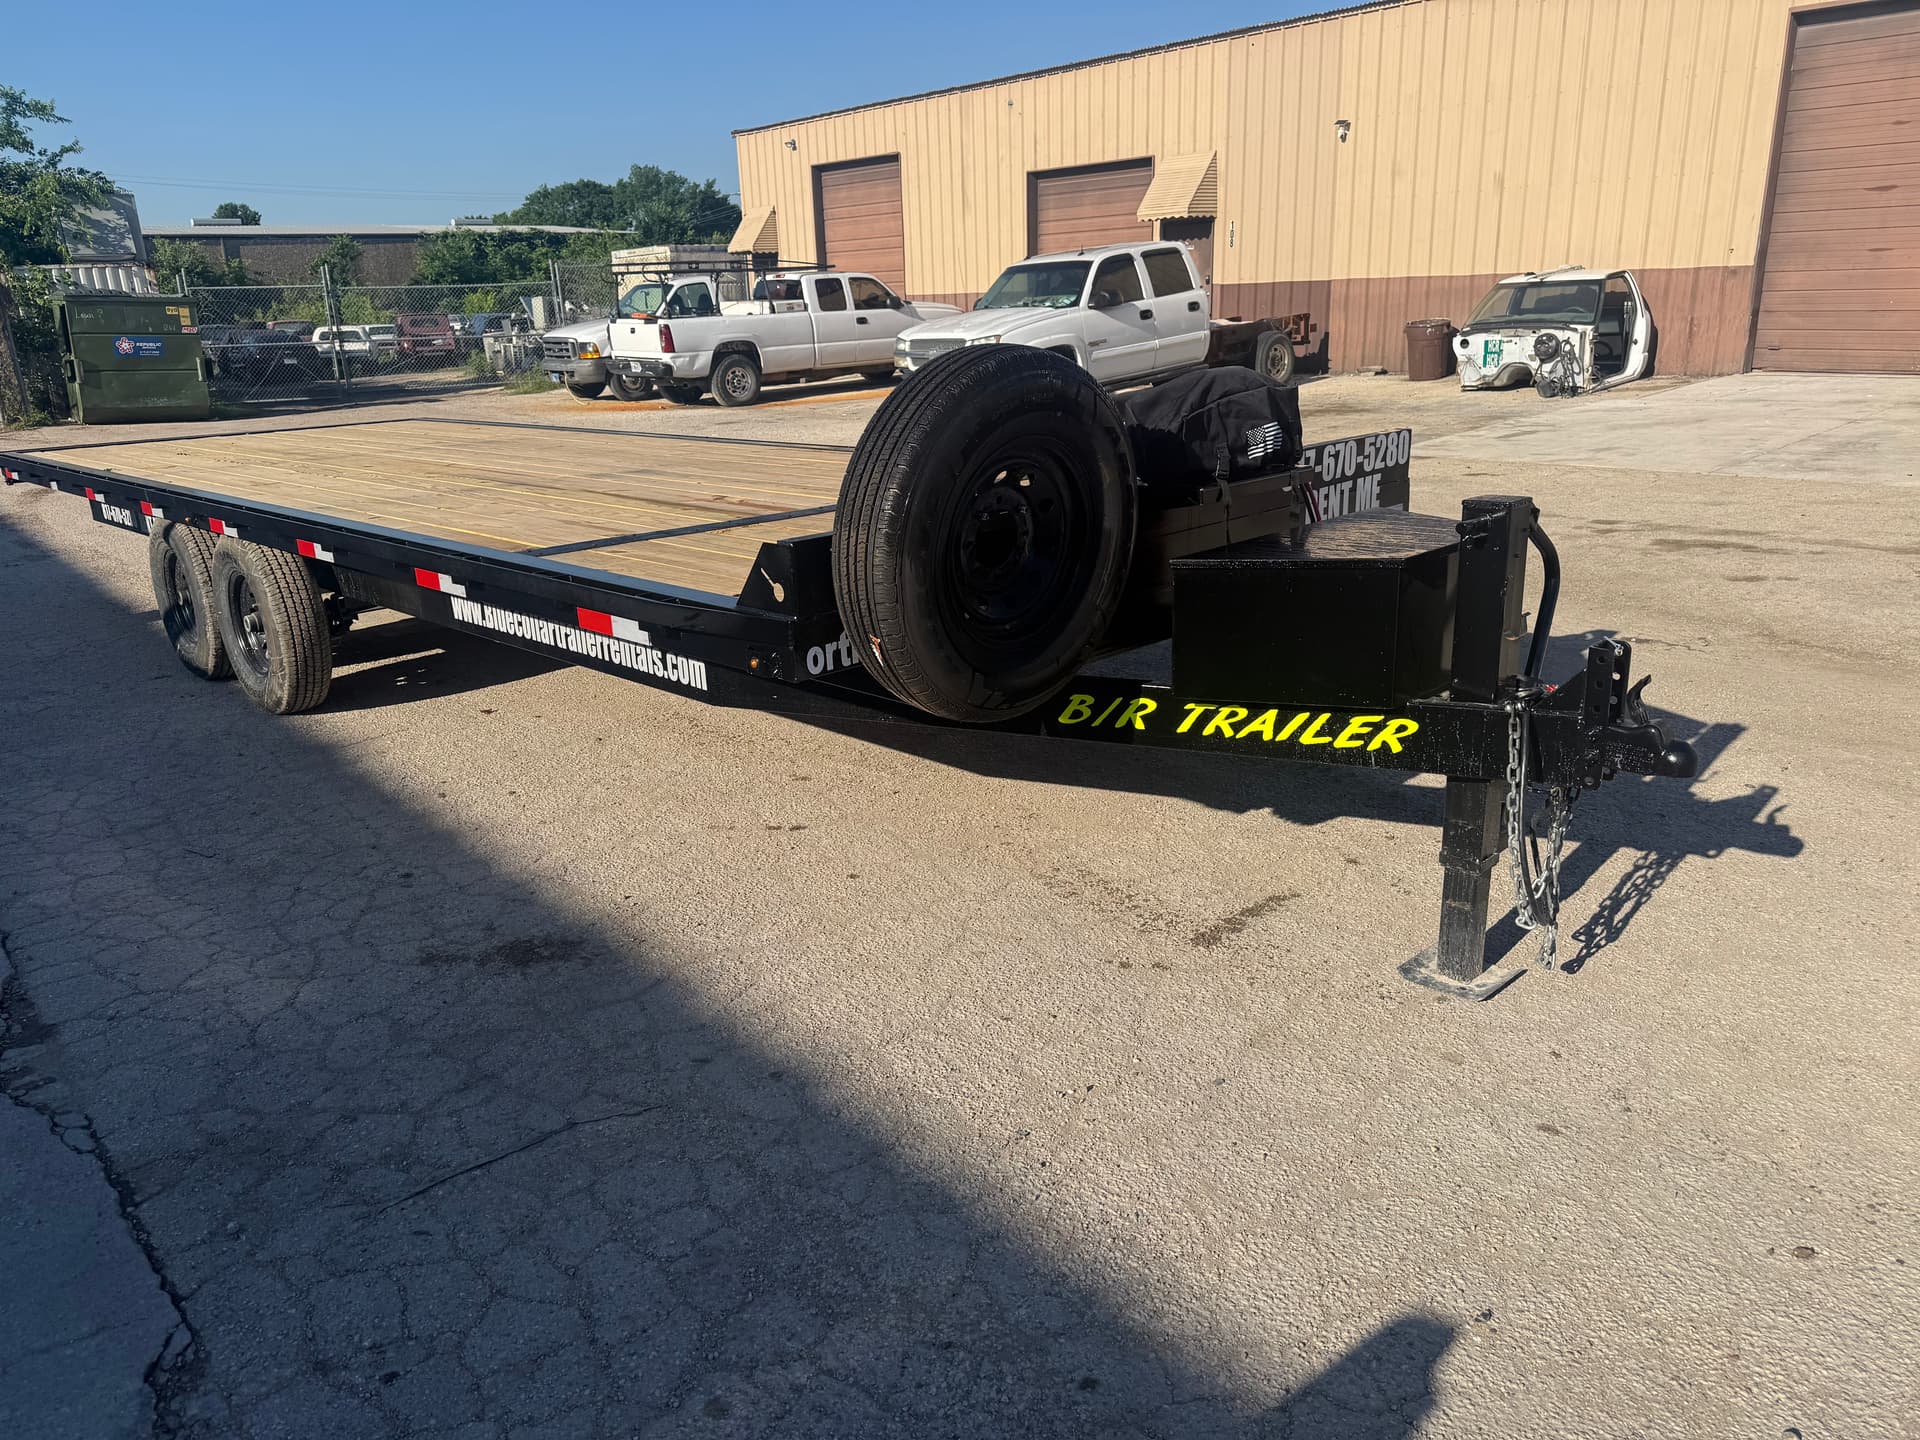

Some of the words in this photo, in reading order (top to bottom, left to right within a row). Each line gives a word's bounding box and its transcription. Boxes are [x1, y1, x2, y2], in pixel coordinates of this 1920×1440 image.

[1355, 473, 1382, 513] ME
[1058, 694, 1157, 730] B/R
[1176, 703, 1419, 754] TRAILER
